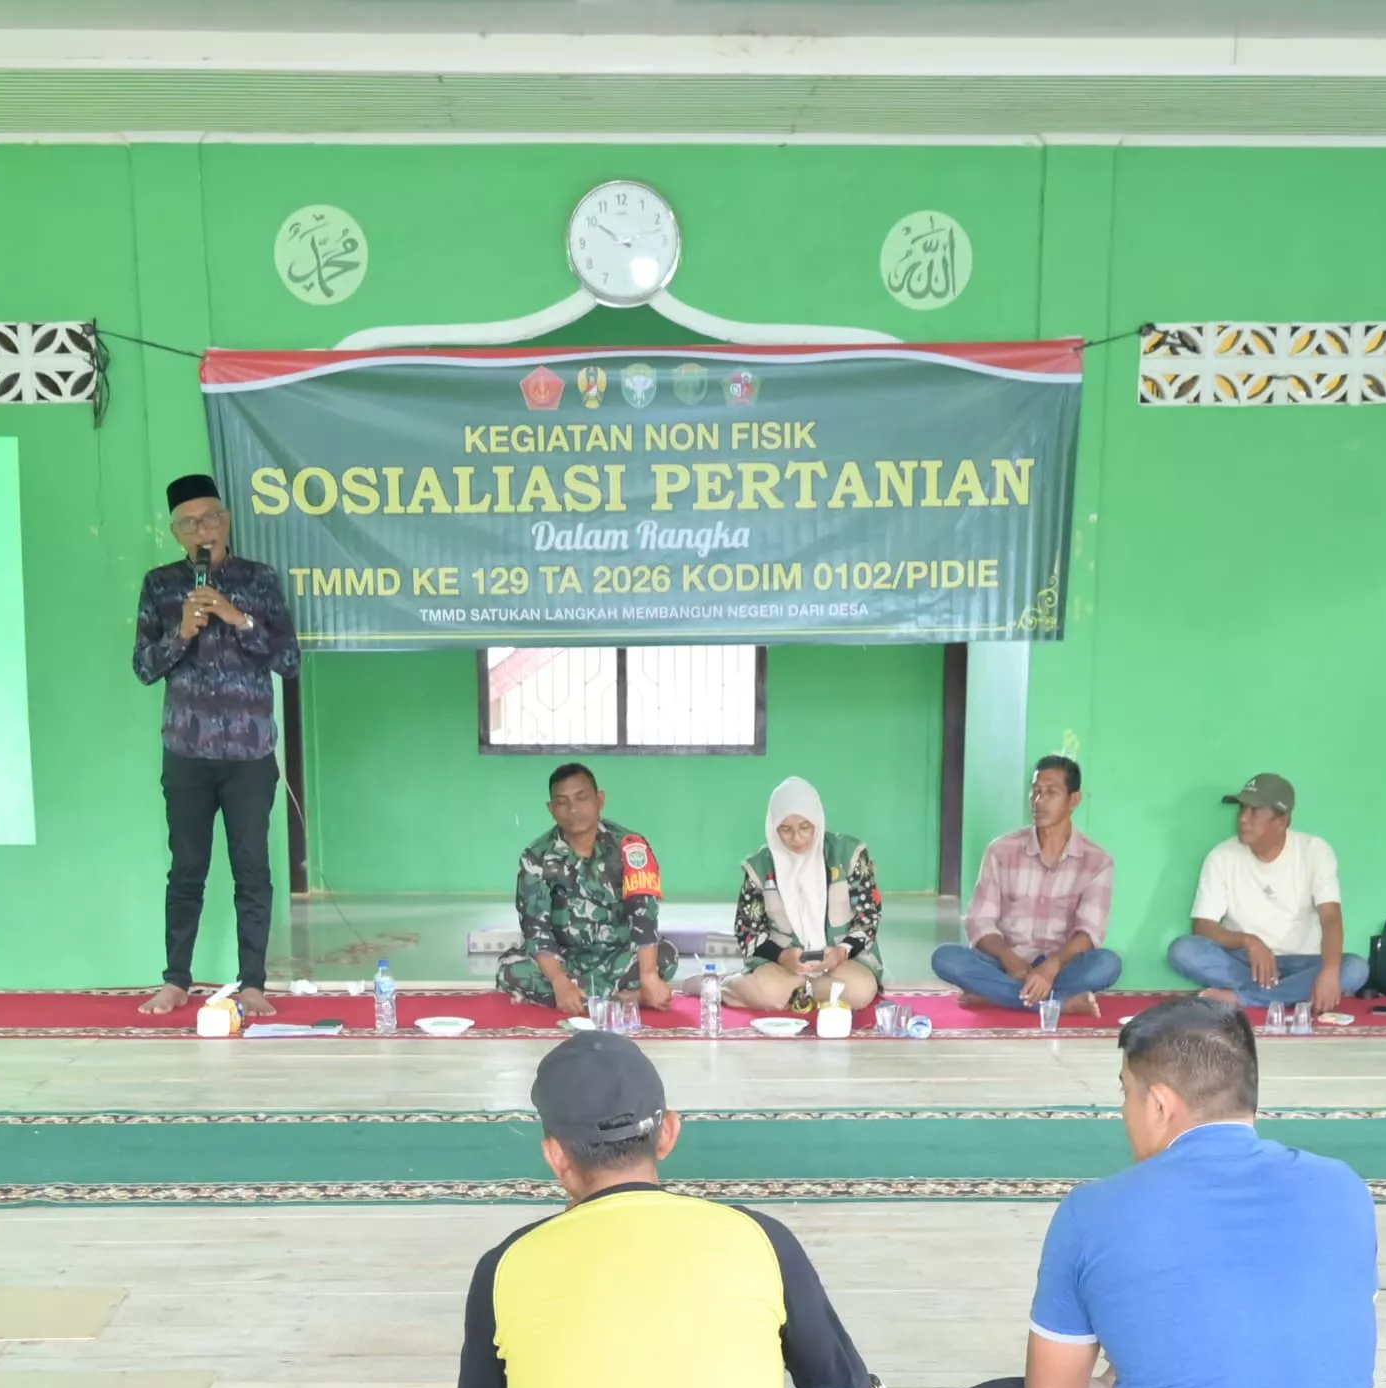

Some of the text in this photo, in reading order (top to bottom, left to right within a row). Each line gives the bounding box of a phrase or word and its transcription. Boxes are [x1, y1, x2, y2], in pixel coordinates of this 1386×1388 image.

[598, 200, 609, 214] 11
[616, 192, 628, 206] 12
[586, 215, 598, 228] 10
[654, 213, 662, 226] 2
[464, 420, 818, 454] KEGIATAN NON FISIK
[250, 458, 1036, 516] SOSIALIASI PERTANIAN
[530, 518, 751, 558] Dalam Rangka
[288, 558, 999, 597] TMMD KE 129 TA 2026 KODIM 0102/PIDIE
[419, 602, 869, 623] TMMD SATUKAN LANGKAH MEMBANGUN NEGERI DARI DESA
